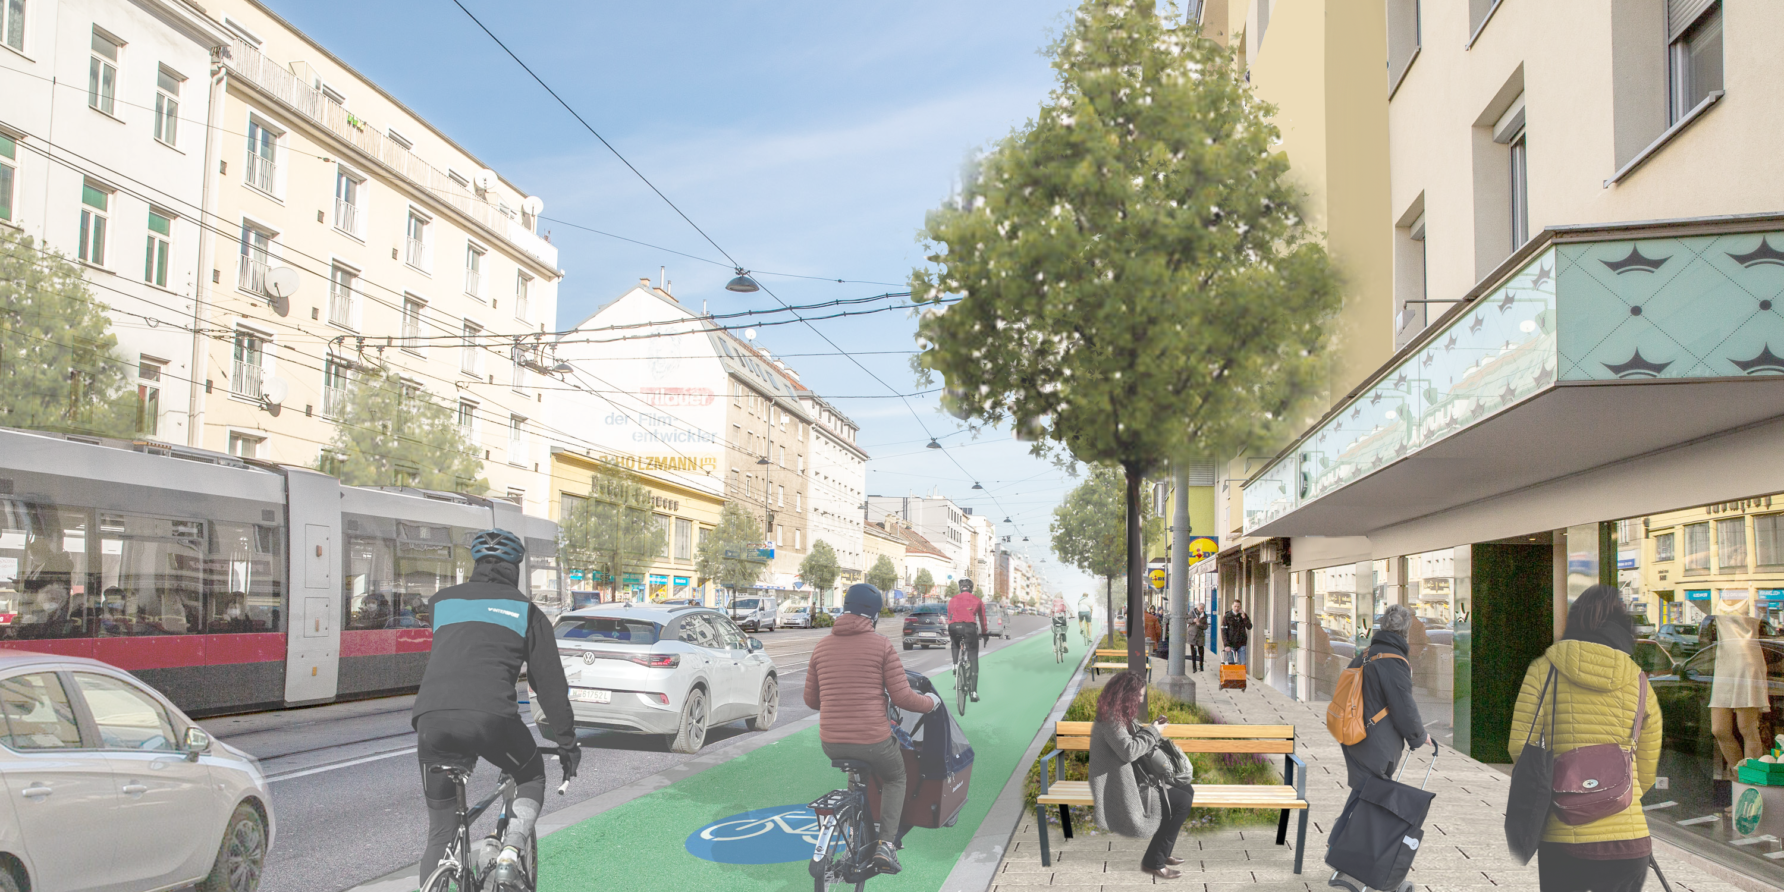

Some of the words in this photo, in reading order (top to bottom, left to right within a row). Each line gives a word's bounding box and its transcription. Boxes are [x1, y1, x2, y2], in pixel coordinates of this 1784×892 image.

[604, 411, 629, 426] der
[638, 413, 679, 427] Film-
[632, 428, 718, 443] entwickler
